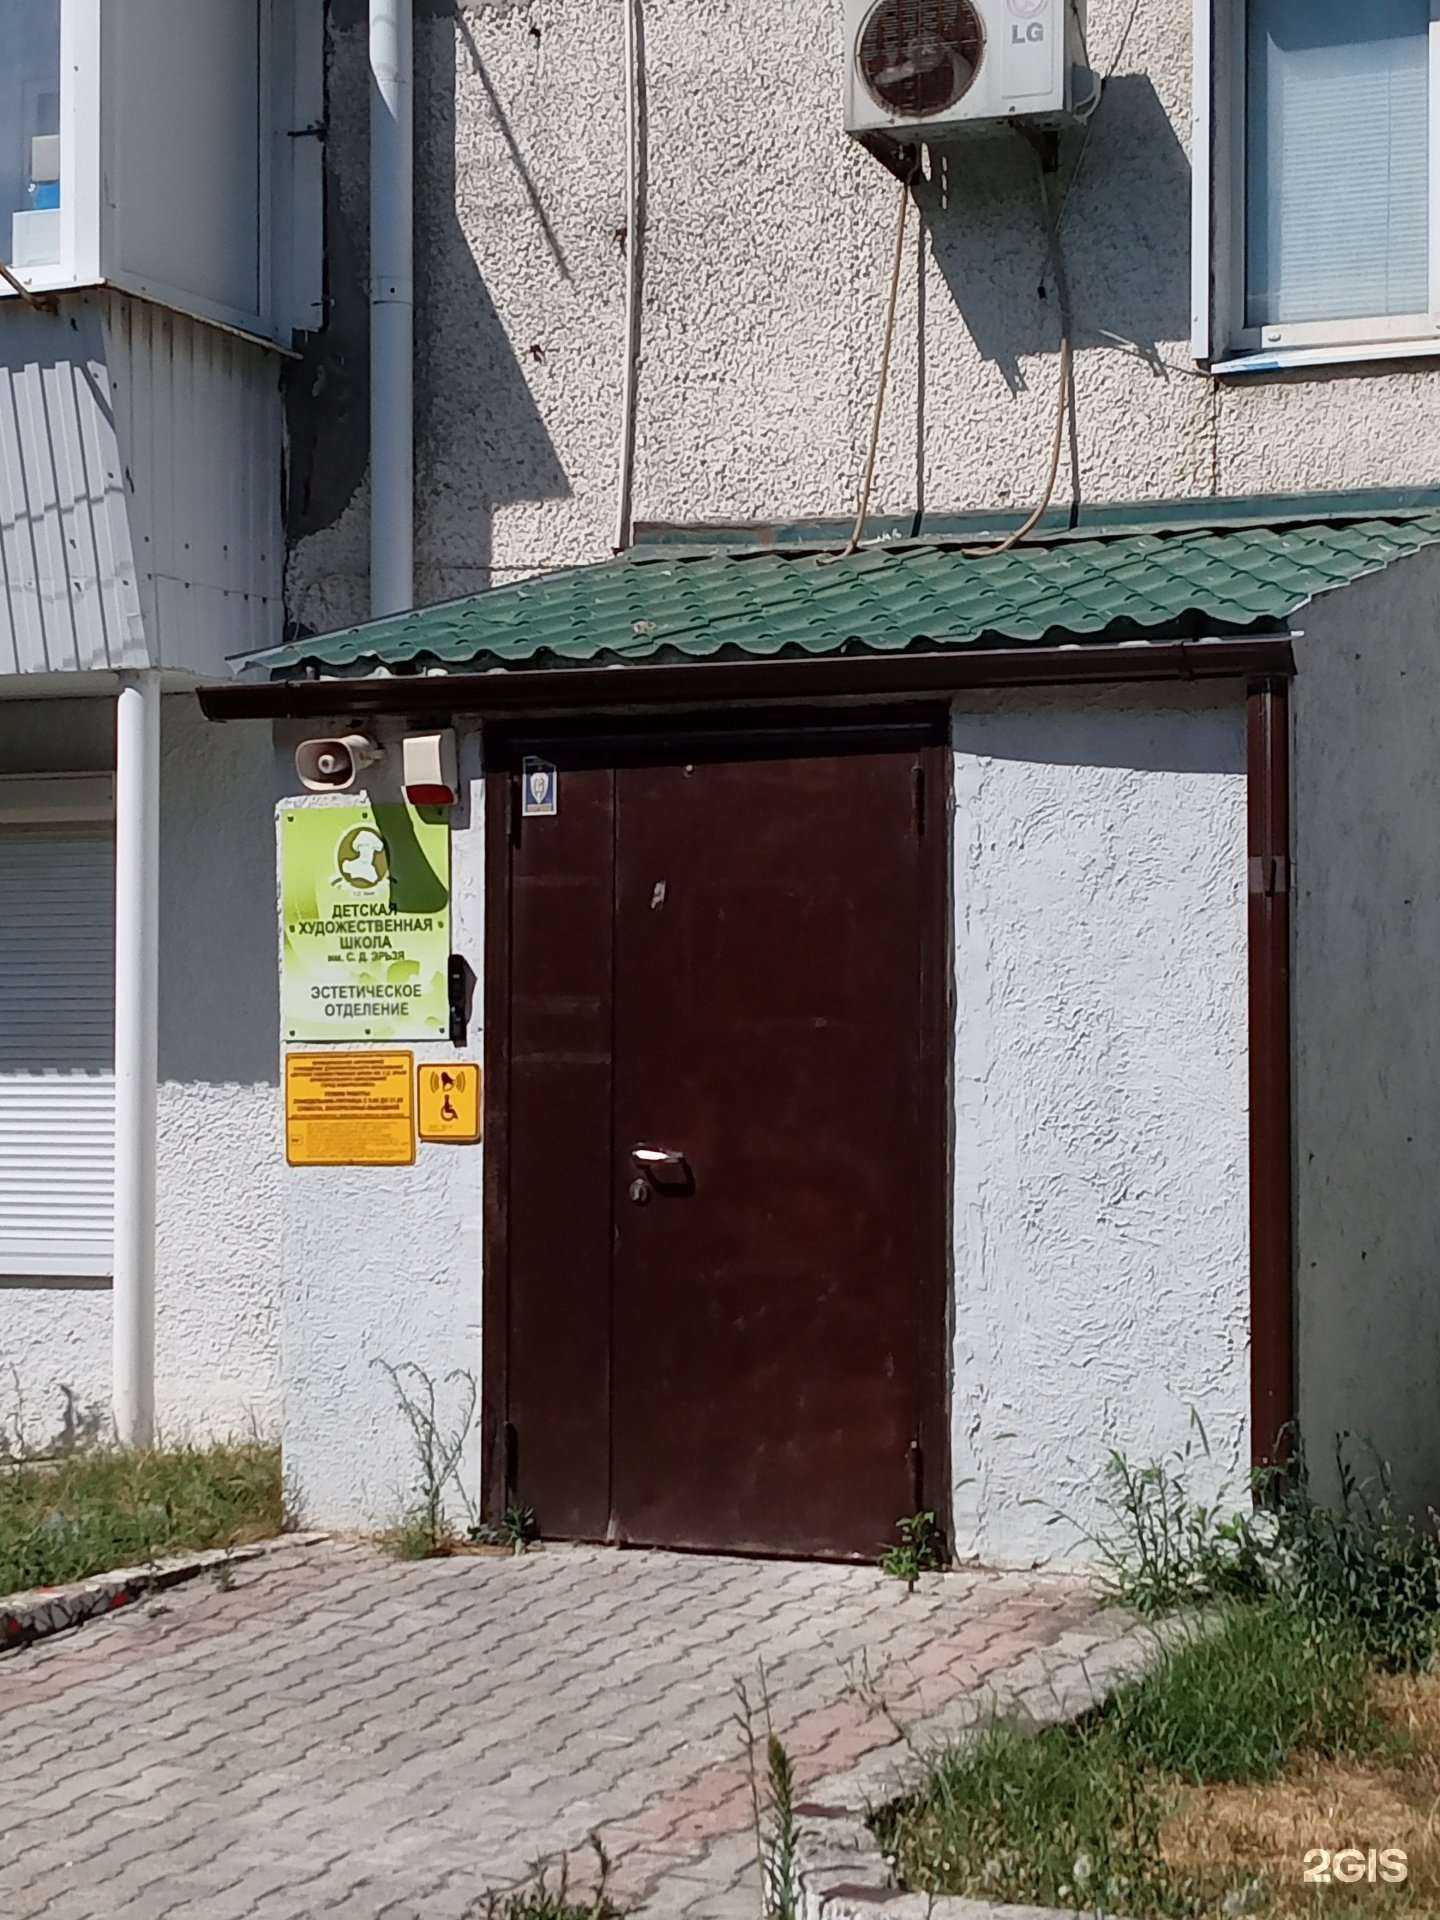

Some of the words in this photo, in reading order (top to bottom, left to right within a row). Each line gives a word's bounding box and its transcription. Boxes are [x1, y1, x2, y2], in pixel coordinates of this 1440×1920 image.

[1011, 23, 1044, 44] LG
[332, 903, 398, 919] ДЕТСКАЯ
[299, 918, 433, 936] ХУДОЖЕСТВЕННАЯ
[340, 935, 392, 949] ШКОЛА
[311, 984, 422, 999] ЭСТЕТИЧЕСКОЕ
[324, 1003, 409, 1018] ОТДЕЛЕНИЕ
